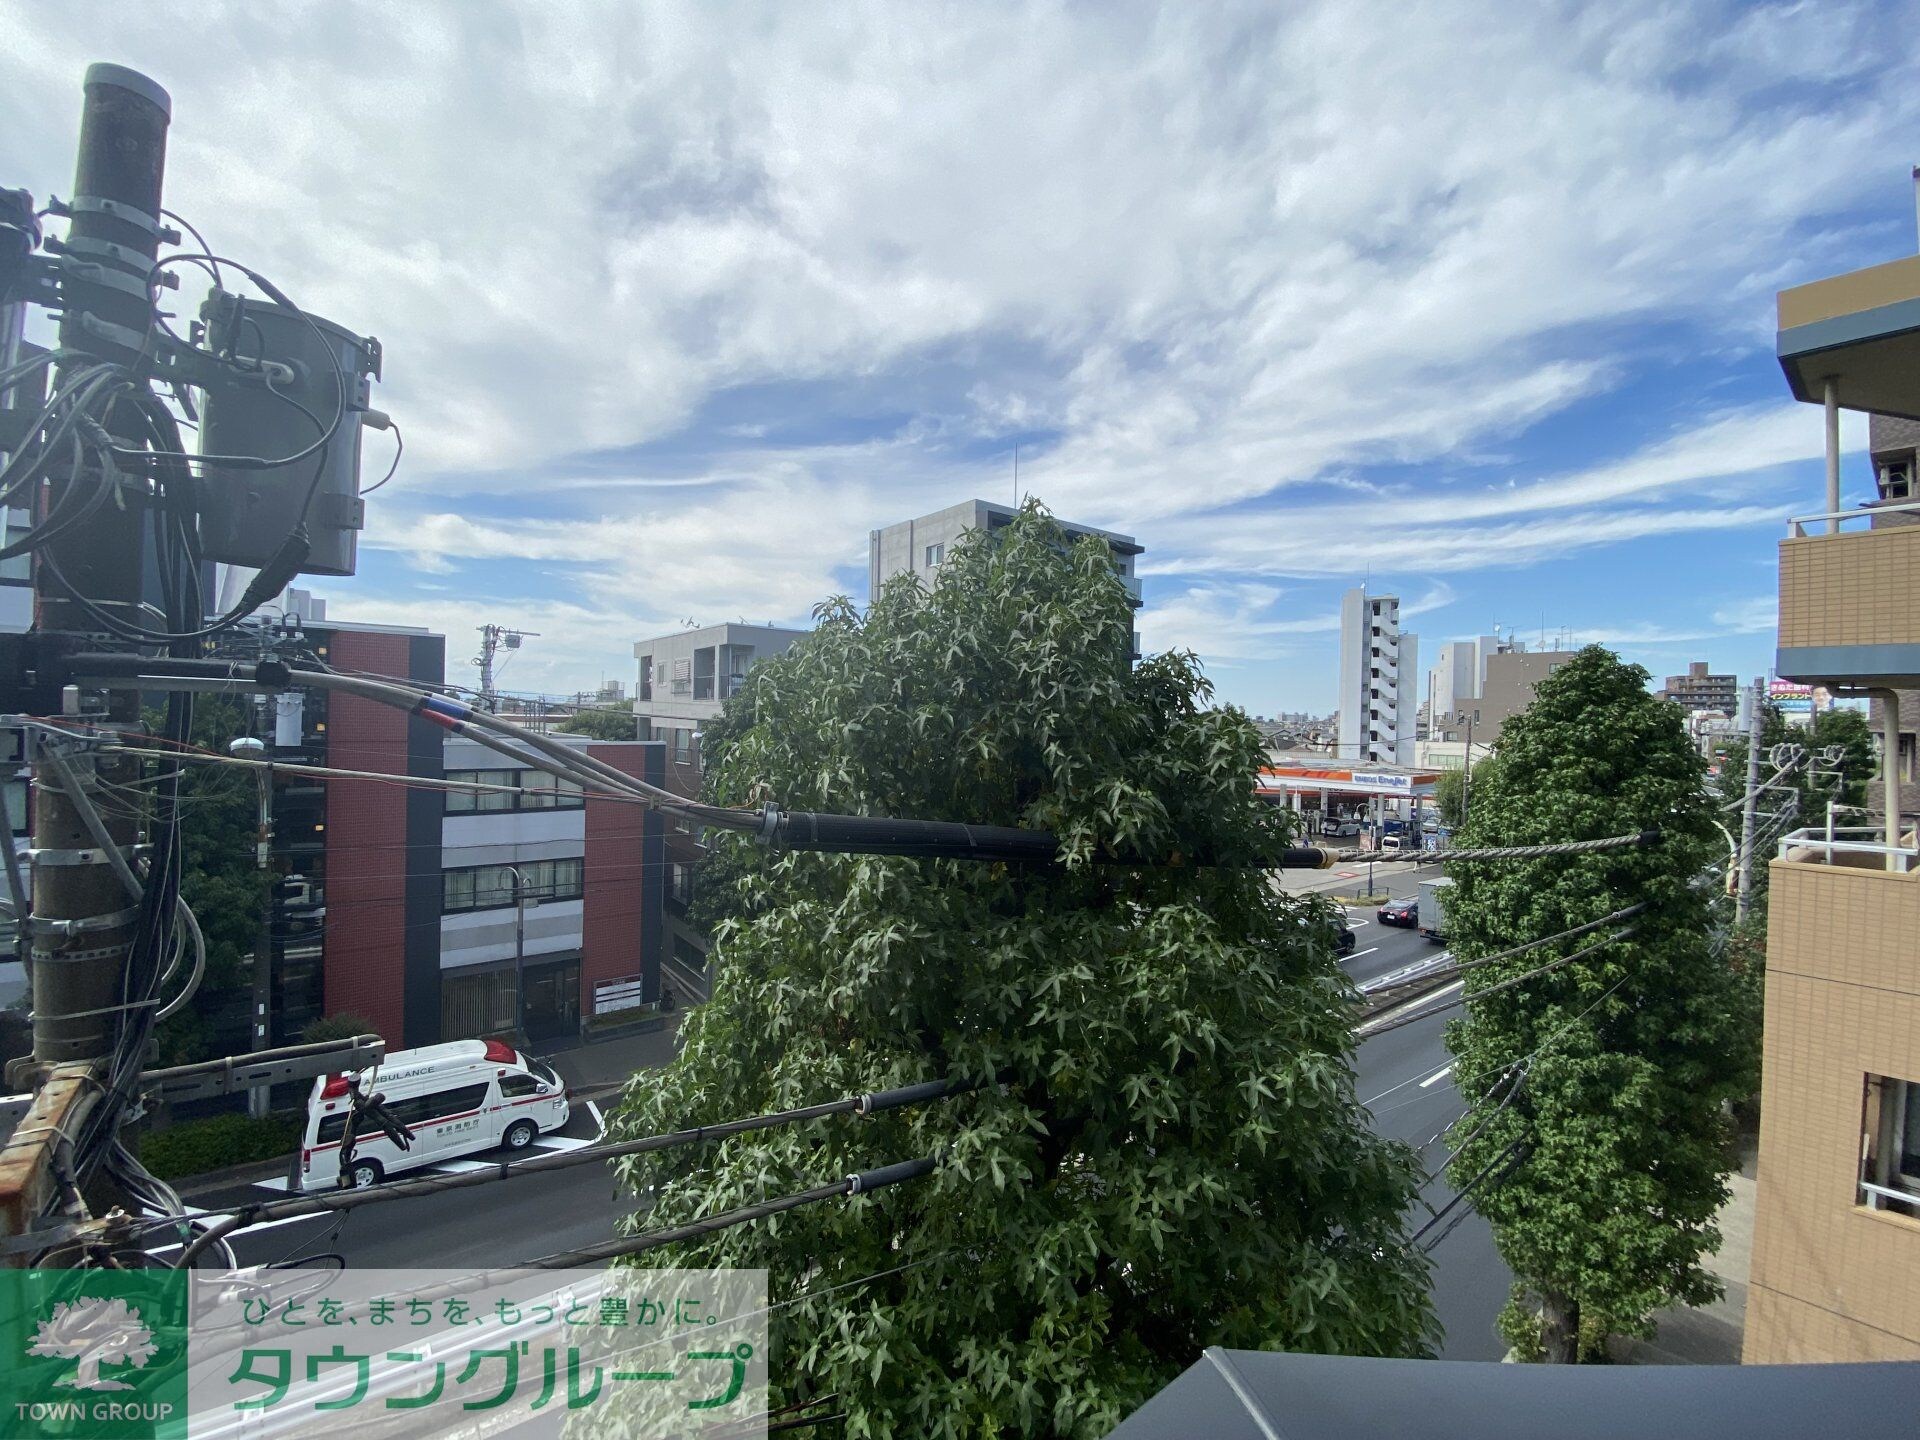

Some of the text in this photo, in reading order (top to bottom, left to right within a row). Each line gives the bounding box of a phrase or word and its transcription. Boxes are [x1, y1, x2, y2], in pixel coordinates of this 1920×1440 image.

[1770, 692, 1811, 700] インプラント
[363, 1066, 436, 1086] AMBULANCE
